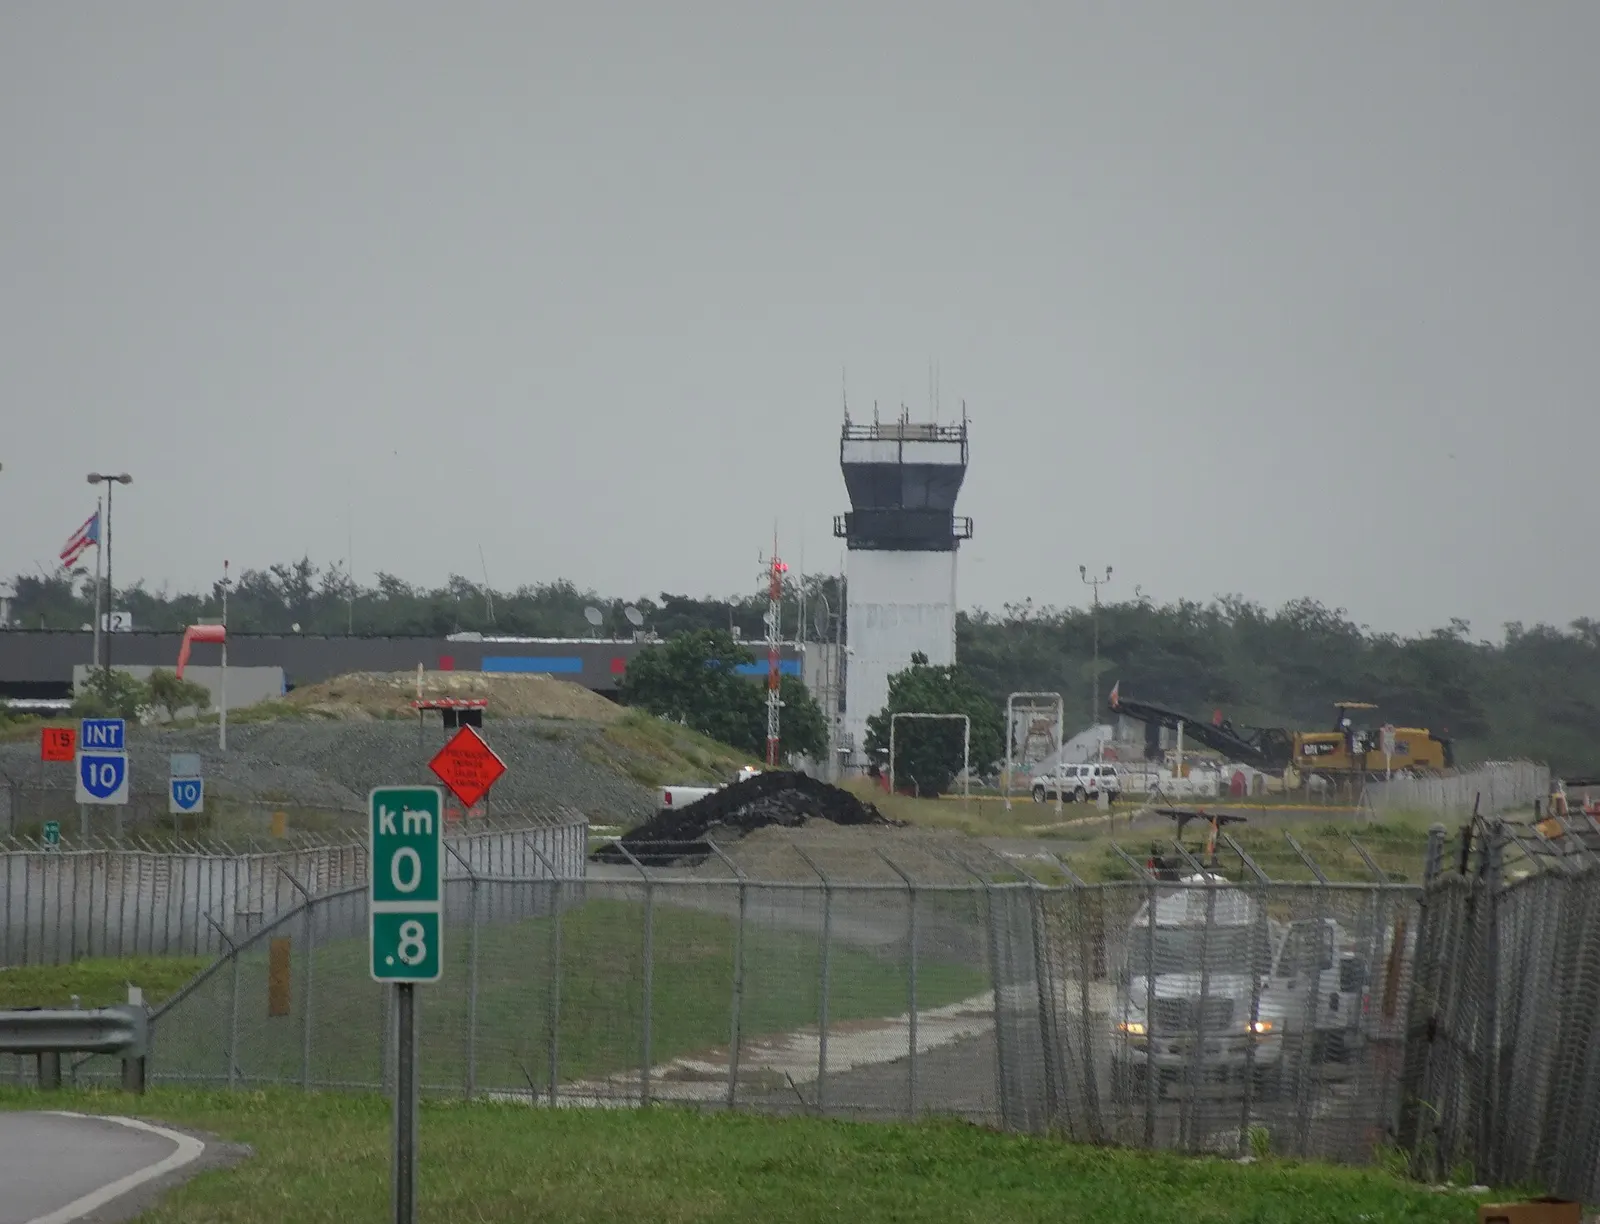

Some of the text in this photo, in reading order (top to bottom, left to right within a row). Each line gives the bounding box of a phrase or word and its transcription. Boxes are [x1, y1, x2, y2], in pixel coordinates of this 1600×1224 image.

[88, 724, 120, 744] INT
[89, 763, 117, 788] 10
[177, 784, 196, 801] 10
[379, 804, 433, 835] km
[391, 846, 422, 893] 0
